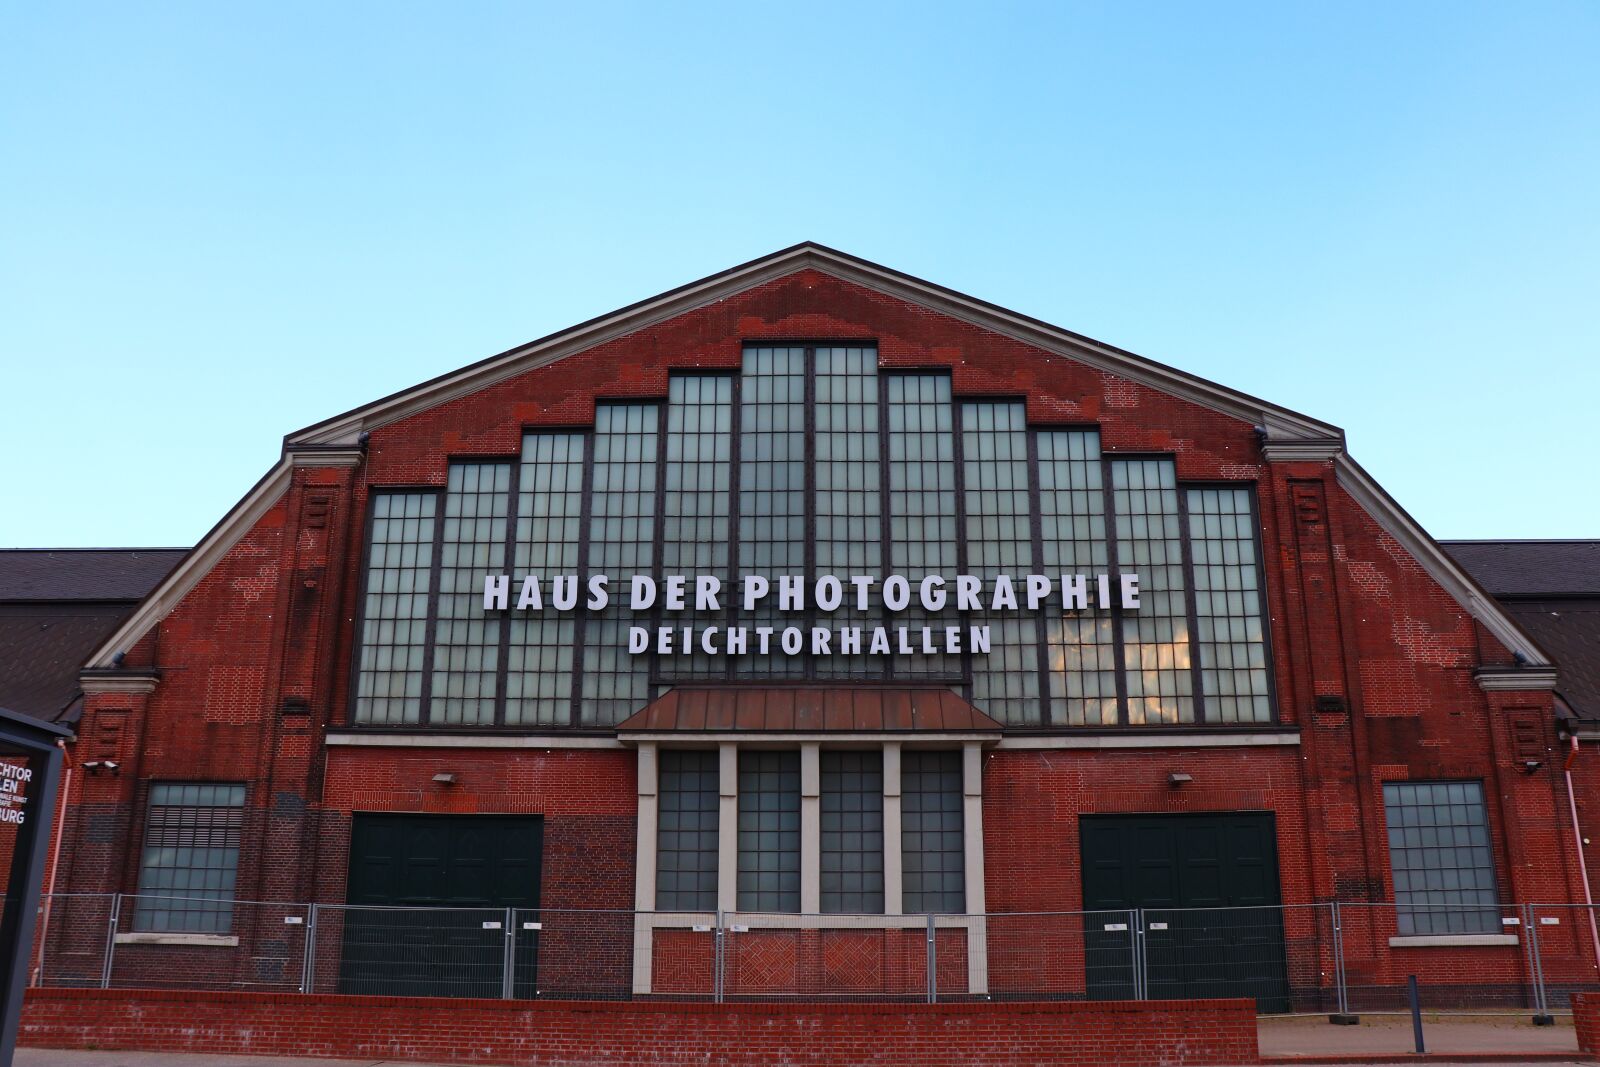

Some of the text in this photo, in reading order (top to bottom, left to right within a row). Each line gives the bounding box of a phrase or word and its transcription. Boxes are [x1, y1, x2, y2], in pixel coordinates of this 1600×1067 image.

[483, 574, 1141, 611] HAUS DER PHOTOGRAPHIE
[628, 626, 991, 655] DEICHTORHALLEN
[0, 808, 24, 824] URG
